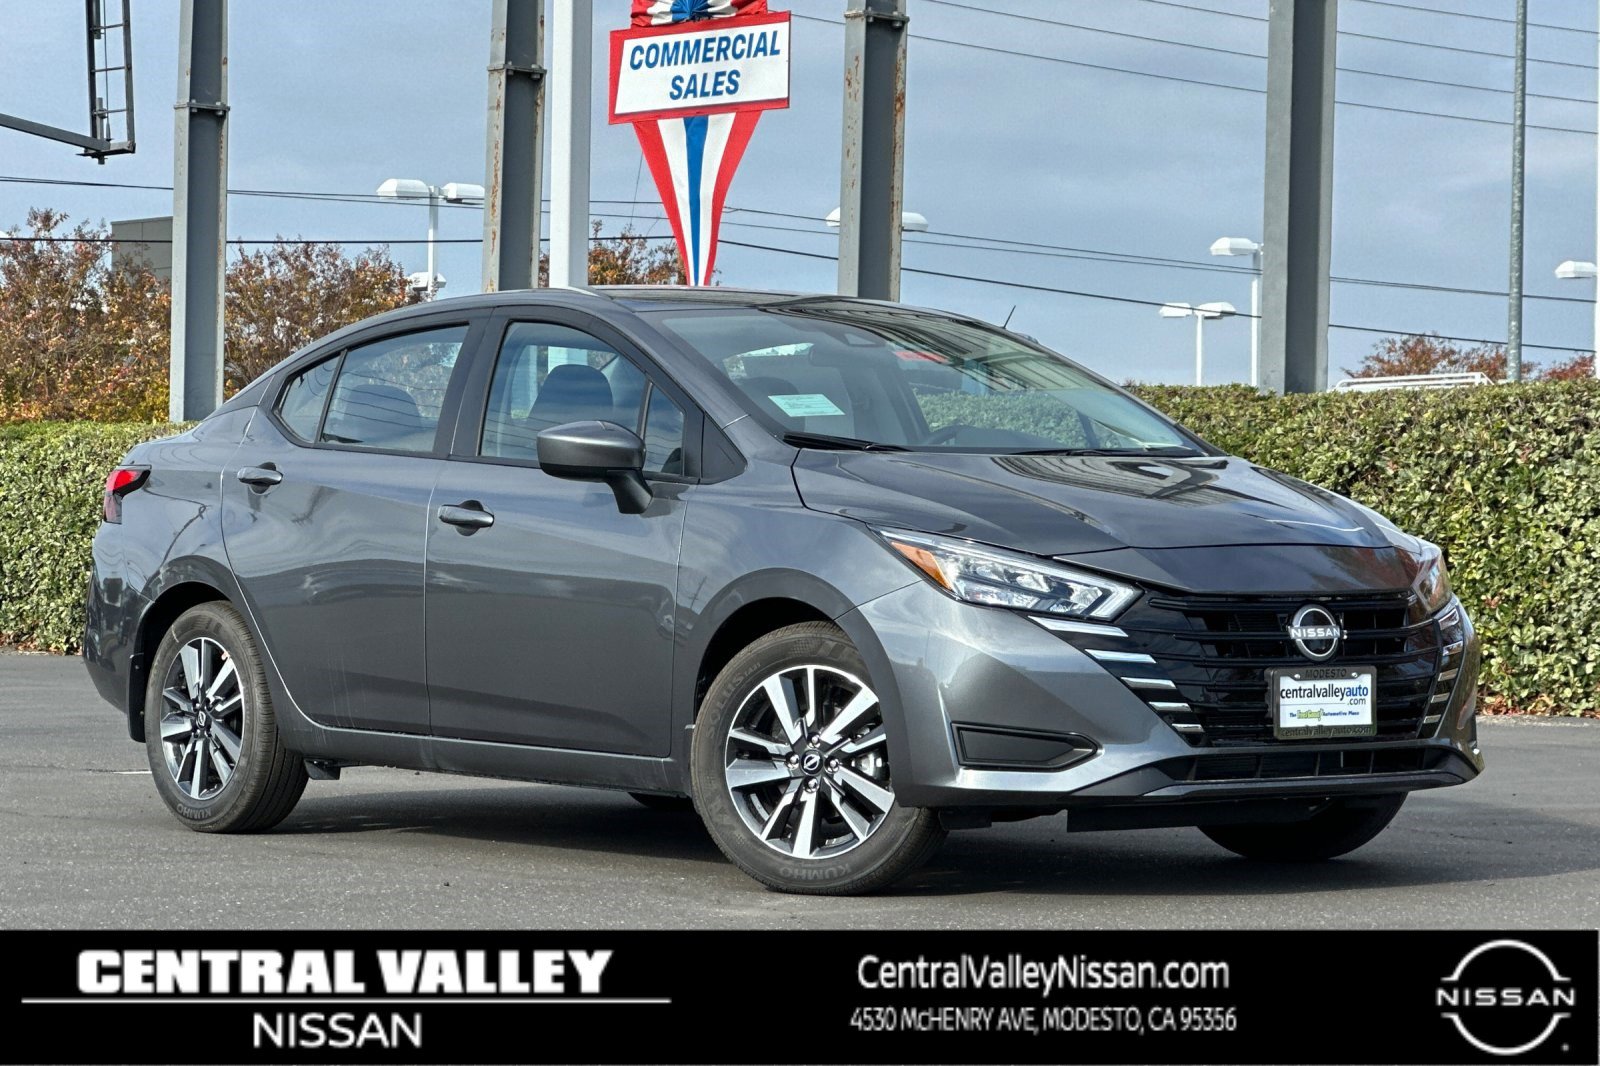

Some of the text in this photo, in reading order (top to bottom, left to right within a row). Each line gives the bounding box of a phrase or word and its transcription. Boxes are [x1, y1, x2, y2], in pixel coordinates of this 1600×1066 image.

[629, 30, 781, 70] COMMERCIAL
[669, 69, 741, 100] SALES
[1291, 627, 1341, 638] NISSAN
[1305, 668, 1347, 679] MODESTO
[1280, 684, 1369, 701] centralvalleyauto
[1347, 697, 1367, 706] .com
[1280, 725, 1373, 738] centralvalleyauto.com
[176, 803, 212, 819] KUMHO
[779, 863, 852, 881] KUMHO
